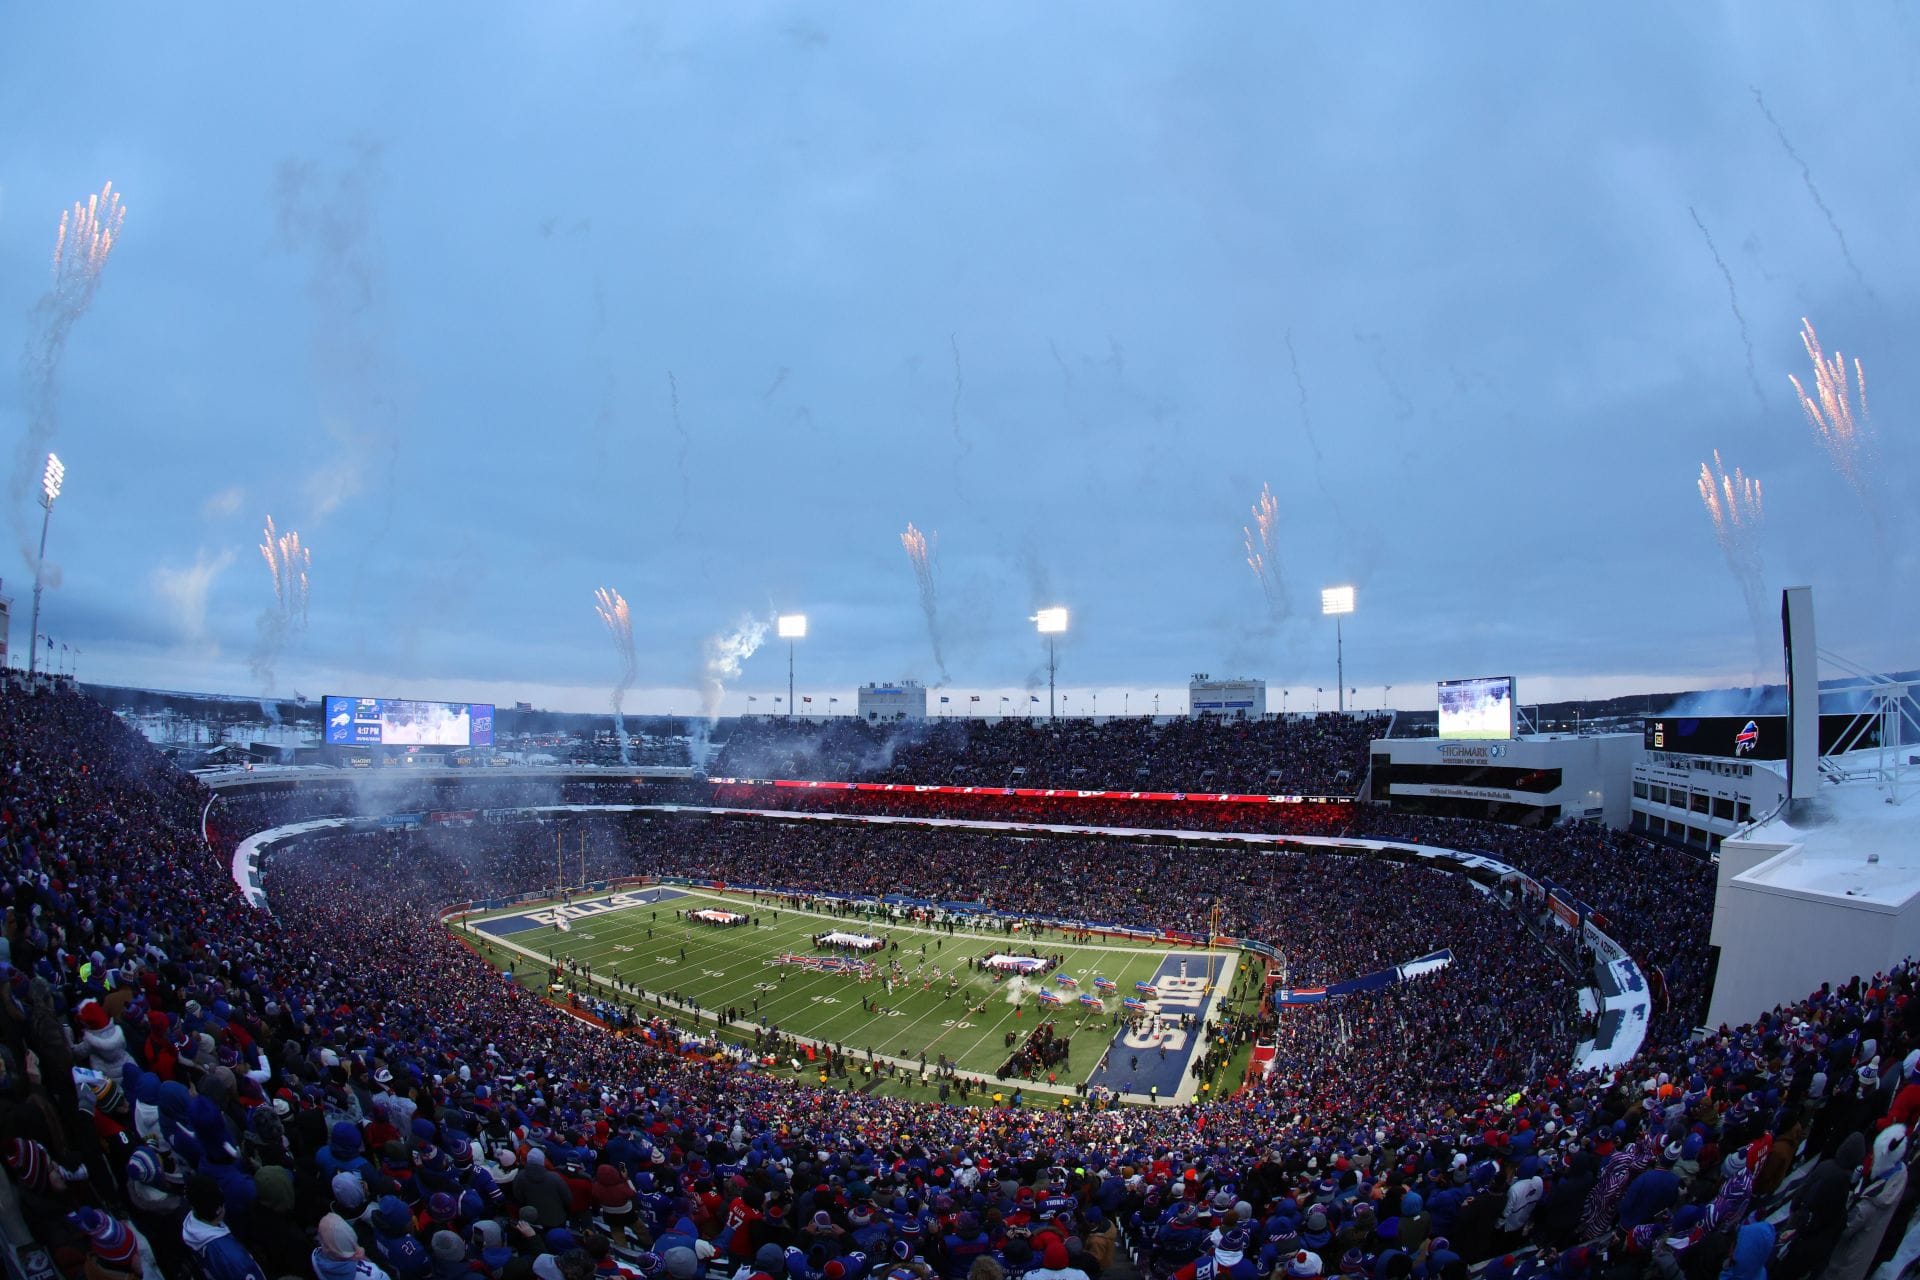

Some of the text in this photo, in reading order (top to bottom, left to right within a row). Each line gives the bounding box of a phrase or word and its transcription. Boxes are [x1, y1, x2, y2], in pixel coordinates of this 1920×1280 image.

[1443, 747, 1488, 757] HIGHMARK
[119, 1131, 129, 1144] 8
[733, 1205, 746, 1218] ALLEN
[726, 1211, 744, 1230] 17
